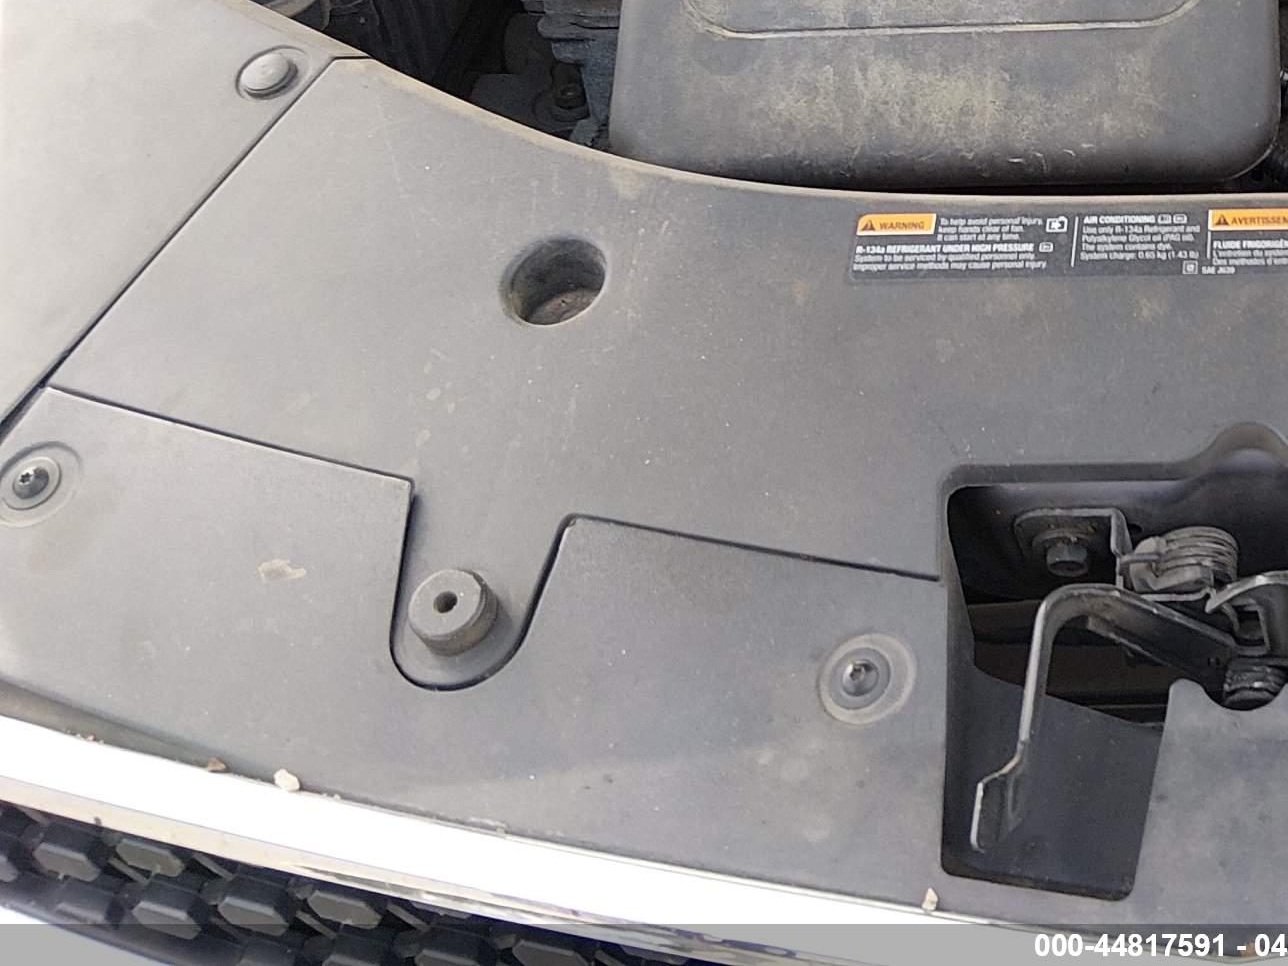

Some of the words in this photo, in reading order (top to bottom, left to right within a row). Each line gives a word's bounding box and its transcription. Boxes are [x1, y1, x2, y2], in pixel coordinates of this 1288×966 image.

[1084, 215, 1098, 224] AIR
[1099, 215, 1155, 224] CONDITIONING
[880, 221, 924, 230] WARNING
[992, 243, 1034, 252] PRESSURE
